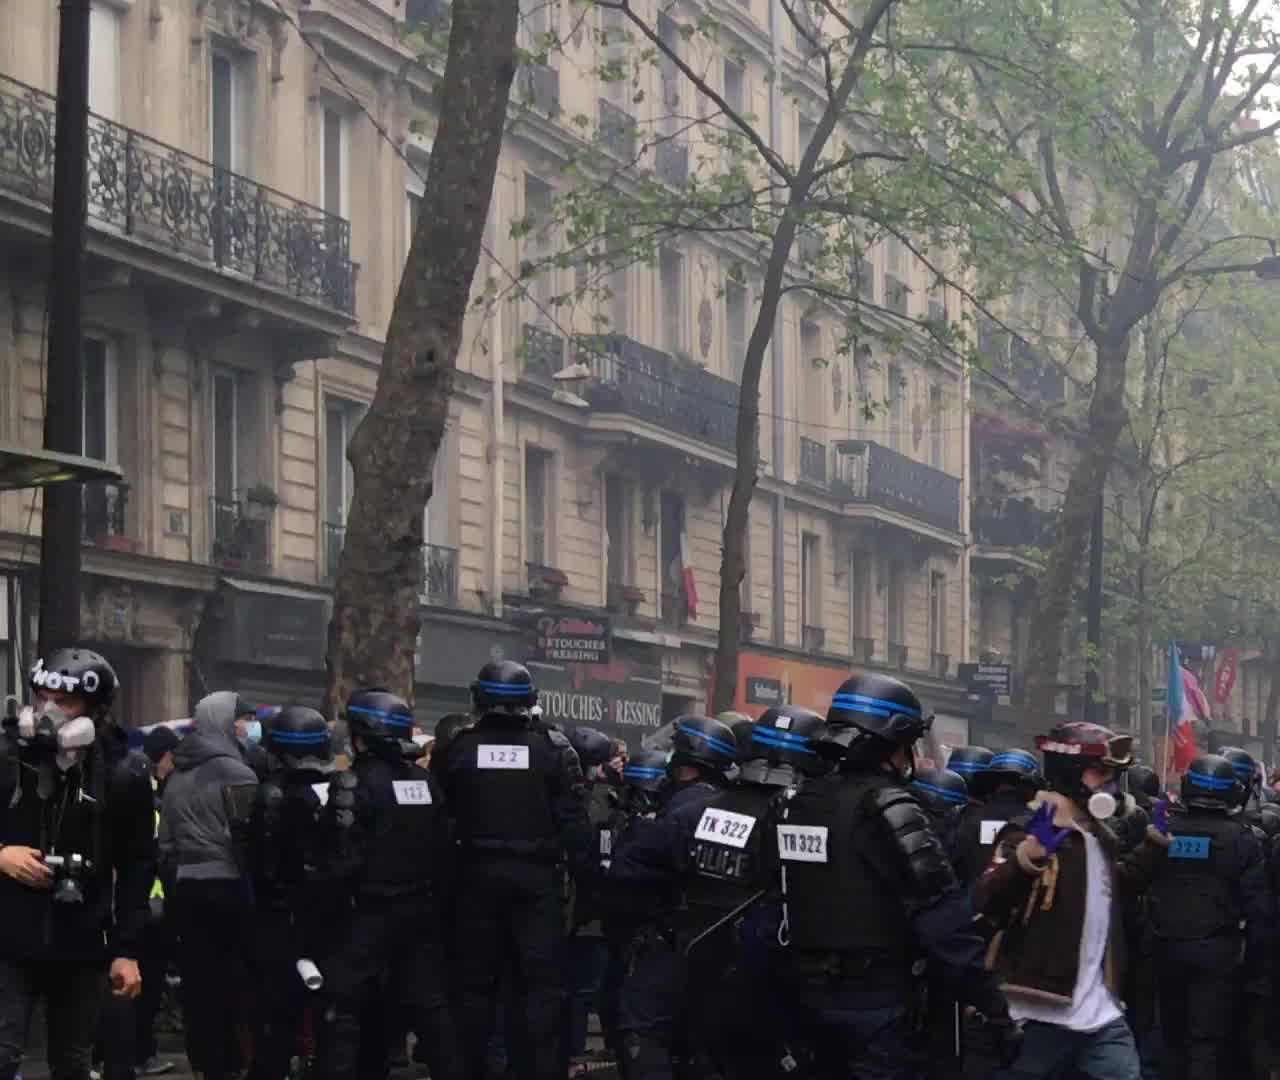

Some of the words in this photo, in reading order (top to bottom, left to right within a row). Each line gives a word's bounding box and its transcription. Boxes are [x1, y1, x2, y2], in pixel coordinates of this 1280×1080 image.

[488, 750, 519, 763] 122
[719, 818, 749, 841] 322
[799, 833, 824, 855] 322
